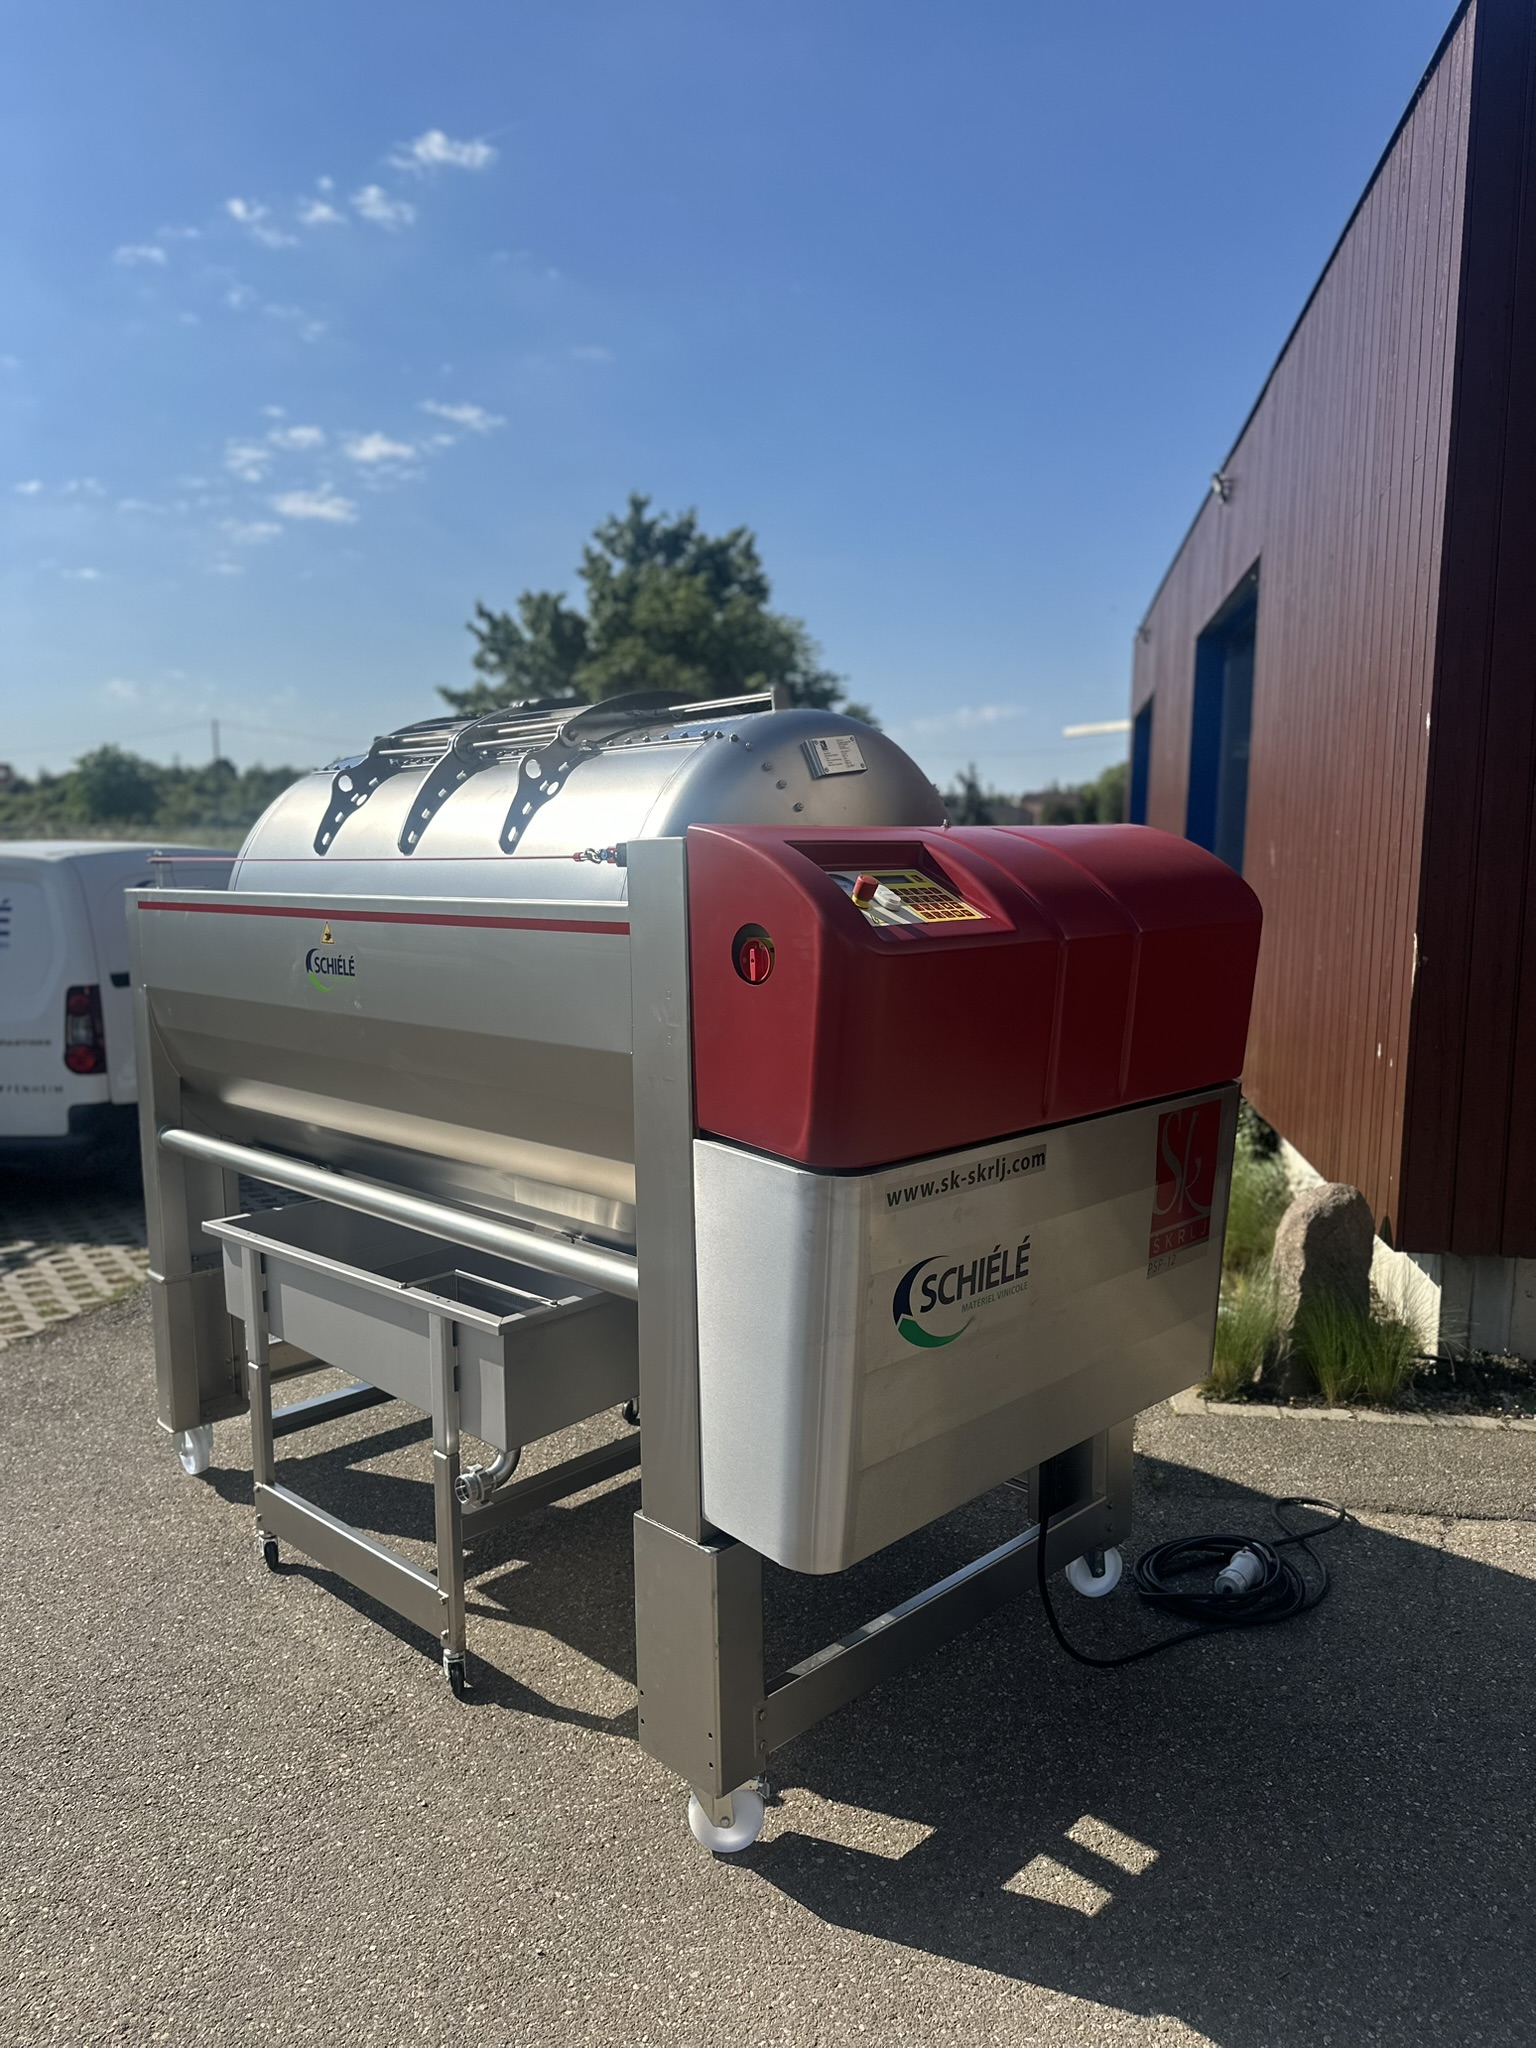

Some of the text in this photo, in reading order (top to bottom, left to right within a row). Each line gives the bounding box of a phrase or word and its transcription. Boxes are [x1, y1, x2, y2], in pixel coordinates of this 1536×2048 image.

[314, 954, 356, 977] SCHIÉLÉ
[886, 1152, 1046, 1208] www.sk-skrlj.com
[920, 1234, 1031, 1313] SCHIÉLÉ
[960, 1294, 996, 1313] MATÉRIEL
